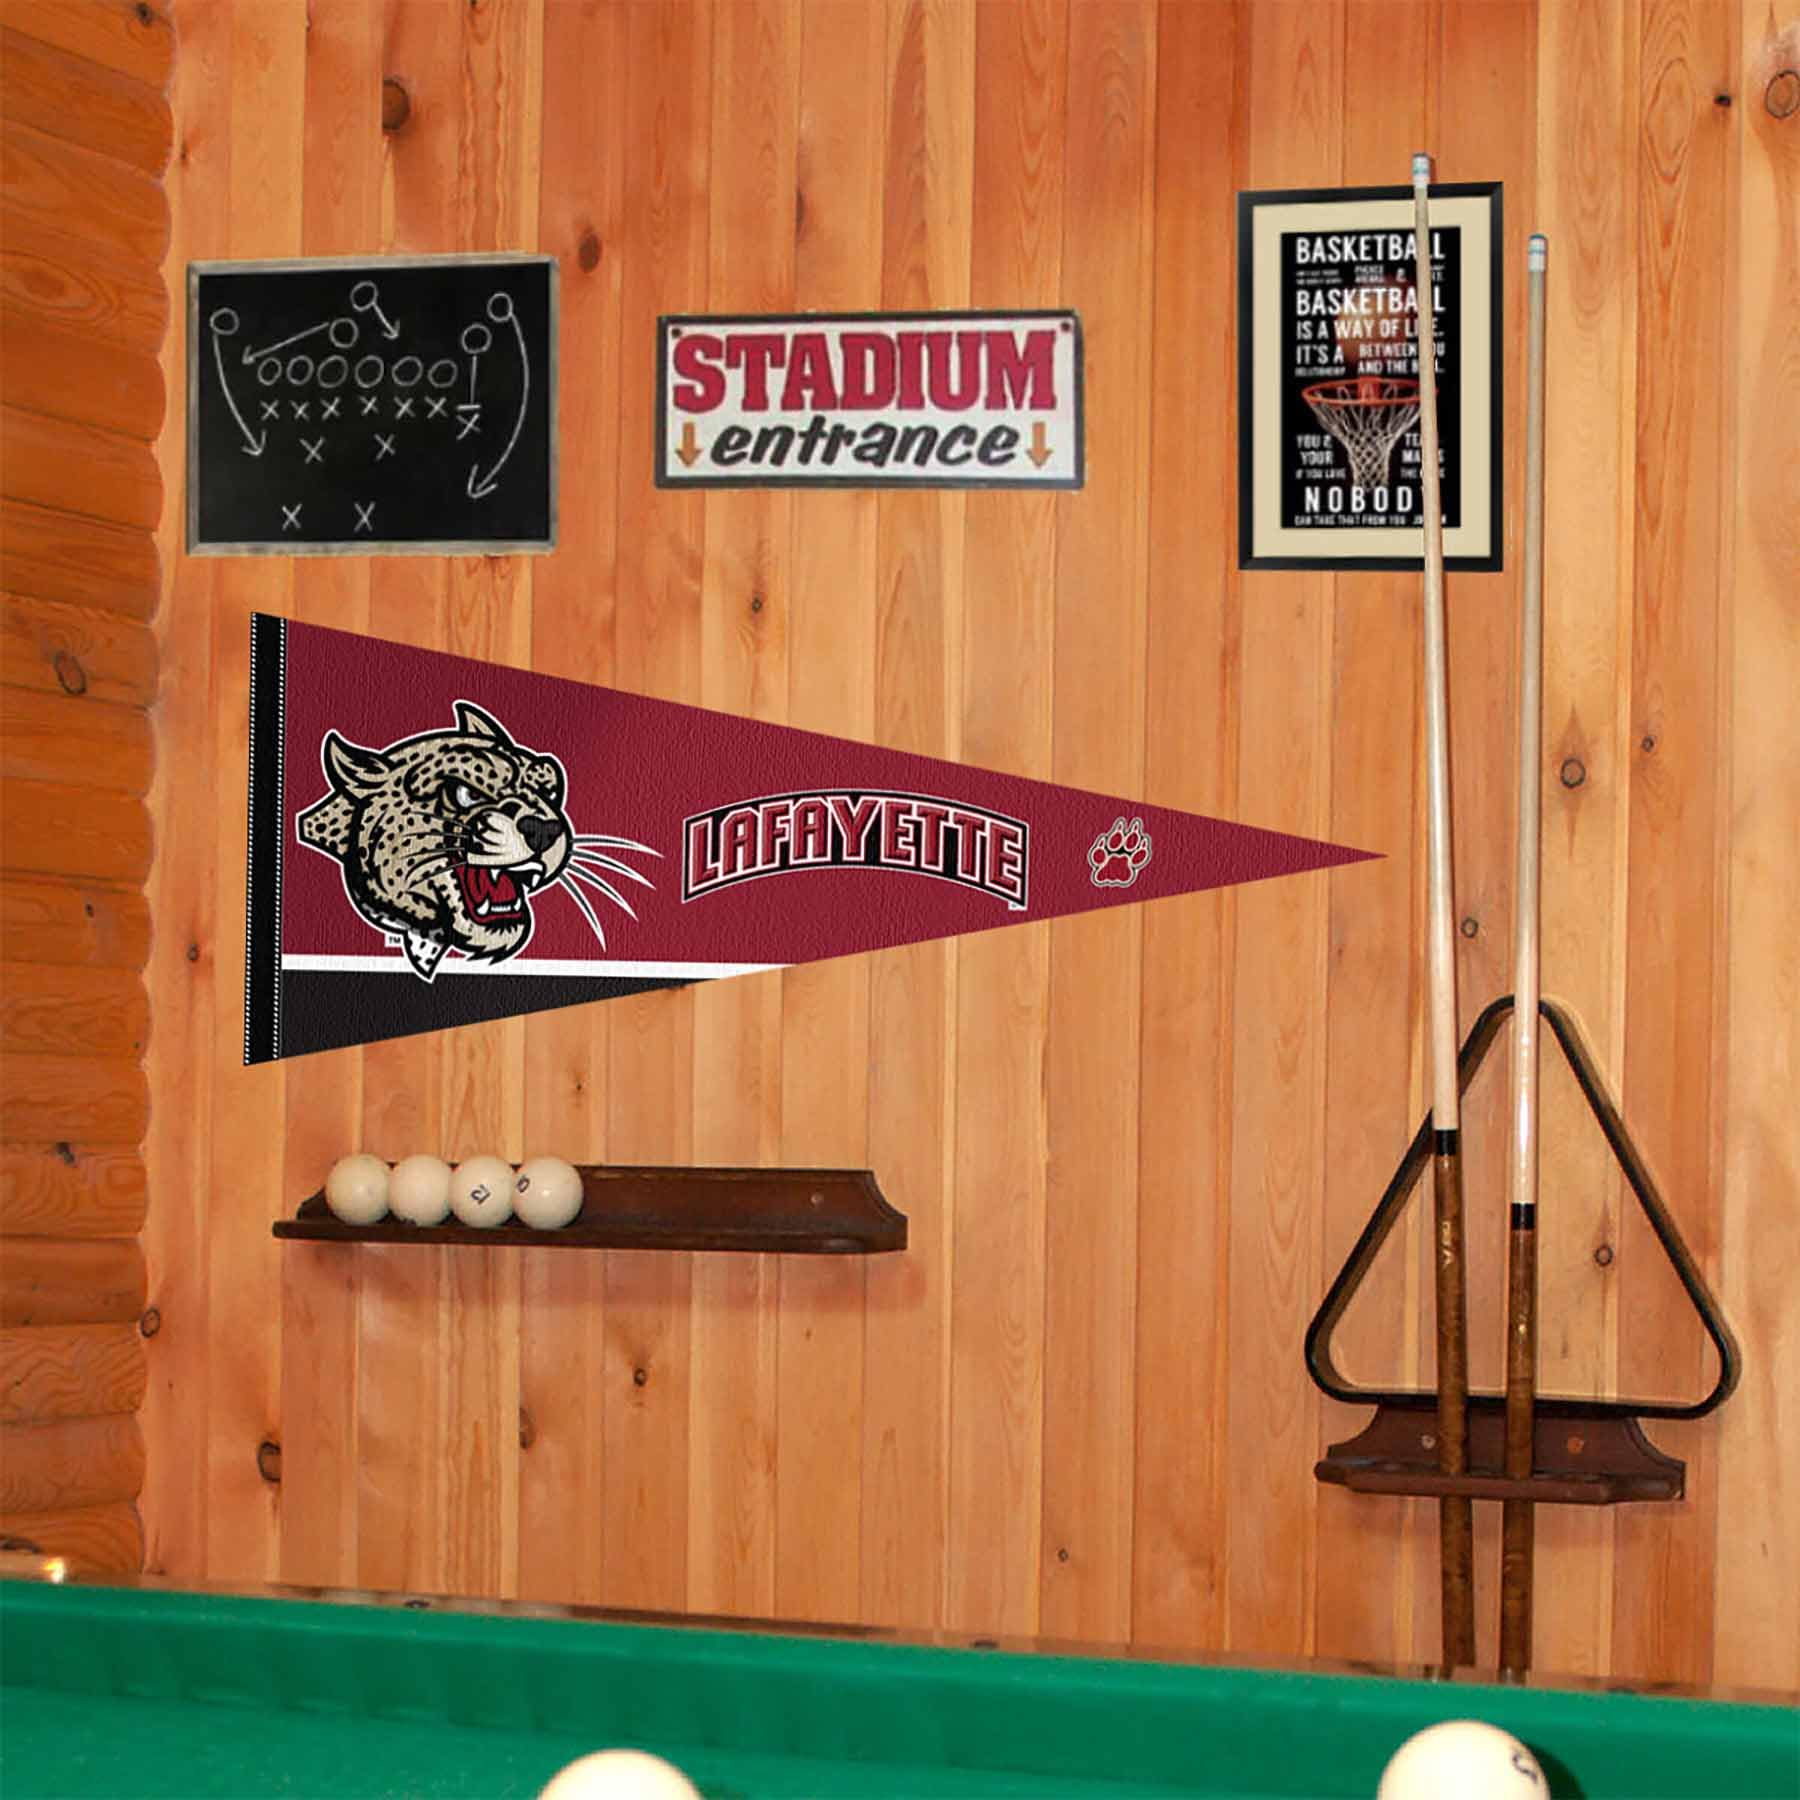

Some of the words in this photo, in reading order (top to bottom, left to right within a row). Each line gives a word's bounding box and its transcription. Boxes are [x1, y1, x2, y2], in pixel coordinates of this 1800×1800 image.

[1296, 232, 1446, 264] BASKETBAL
[1296, 286, 1446, 316] BASKETBAL
[1296, 320, 1313, 340] IS
[1317, 320, 1329, 339] A
[1333, 319, 1375, 339] WAY
[1379, 318, 1399, 338] OF
[1296, 344, 1329, 365] IT'S
[1333, 344, 1344, 364] A
[1359, 342, 1417, 358] BETWEEN
[1358, 360, 1383, 375] AND
[1387, 359, 1408, 374] THE
[673, 330, 1057, 413] STADIUM
[711, 415, 1020, 468] entrance
[1296, 434, 1320, 449] YOU
[1300, 451, 1333, 465] YOUR
[1305, 486, 1424, 513] NOBOD
[687, 794, 1025, 902] LAFAYETTE
